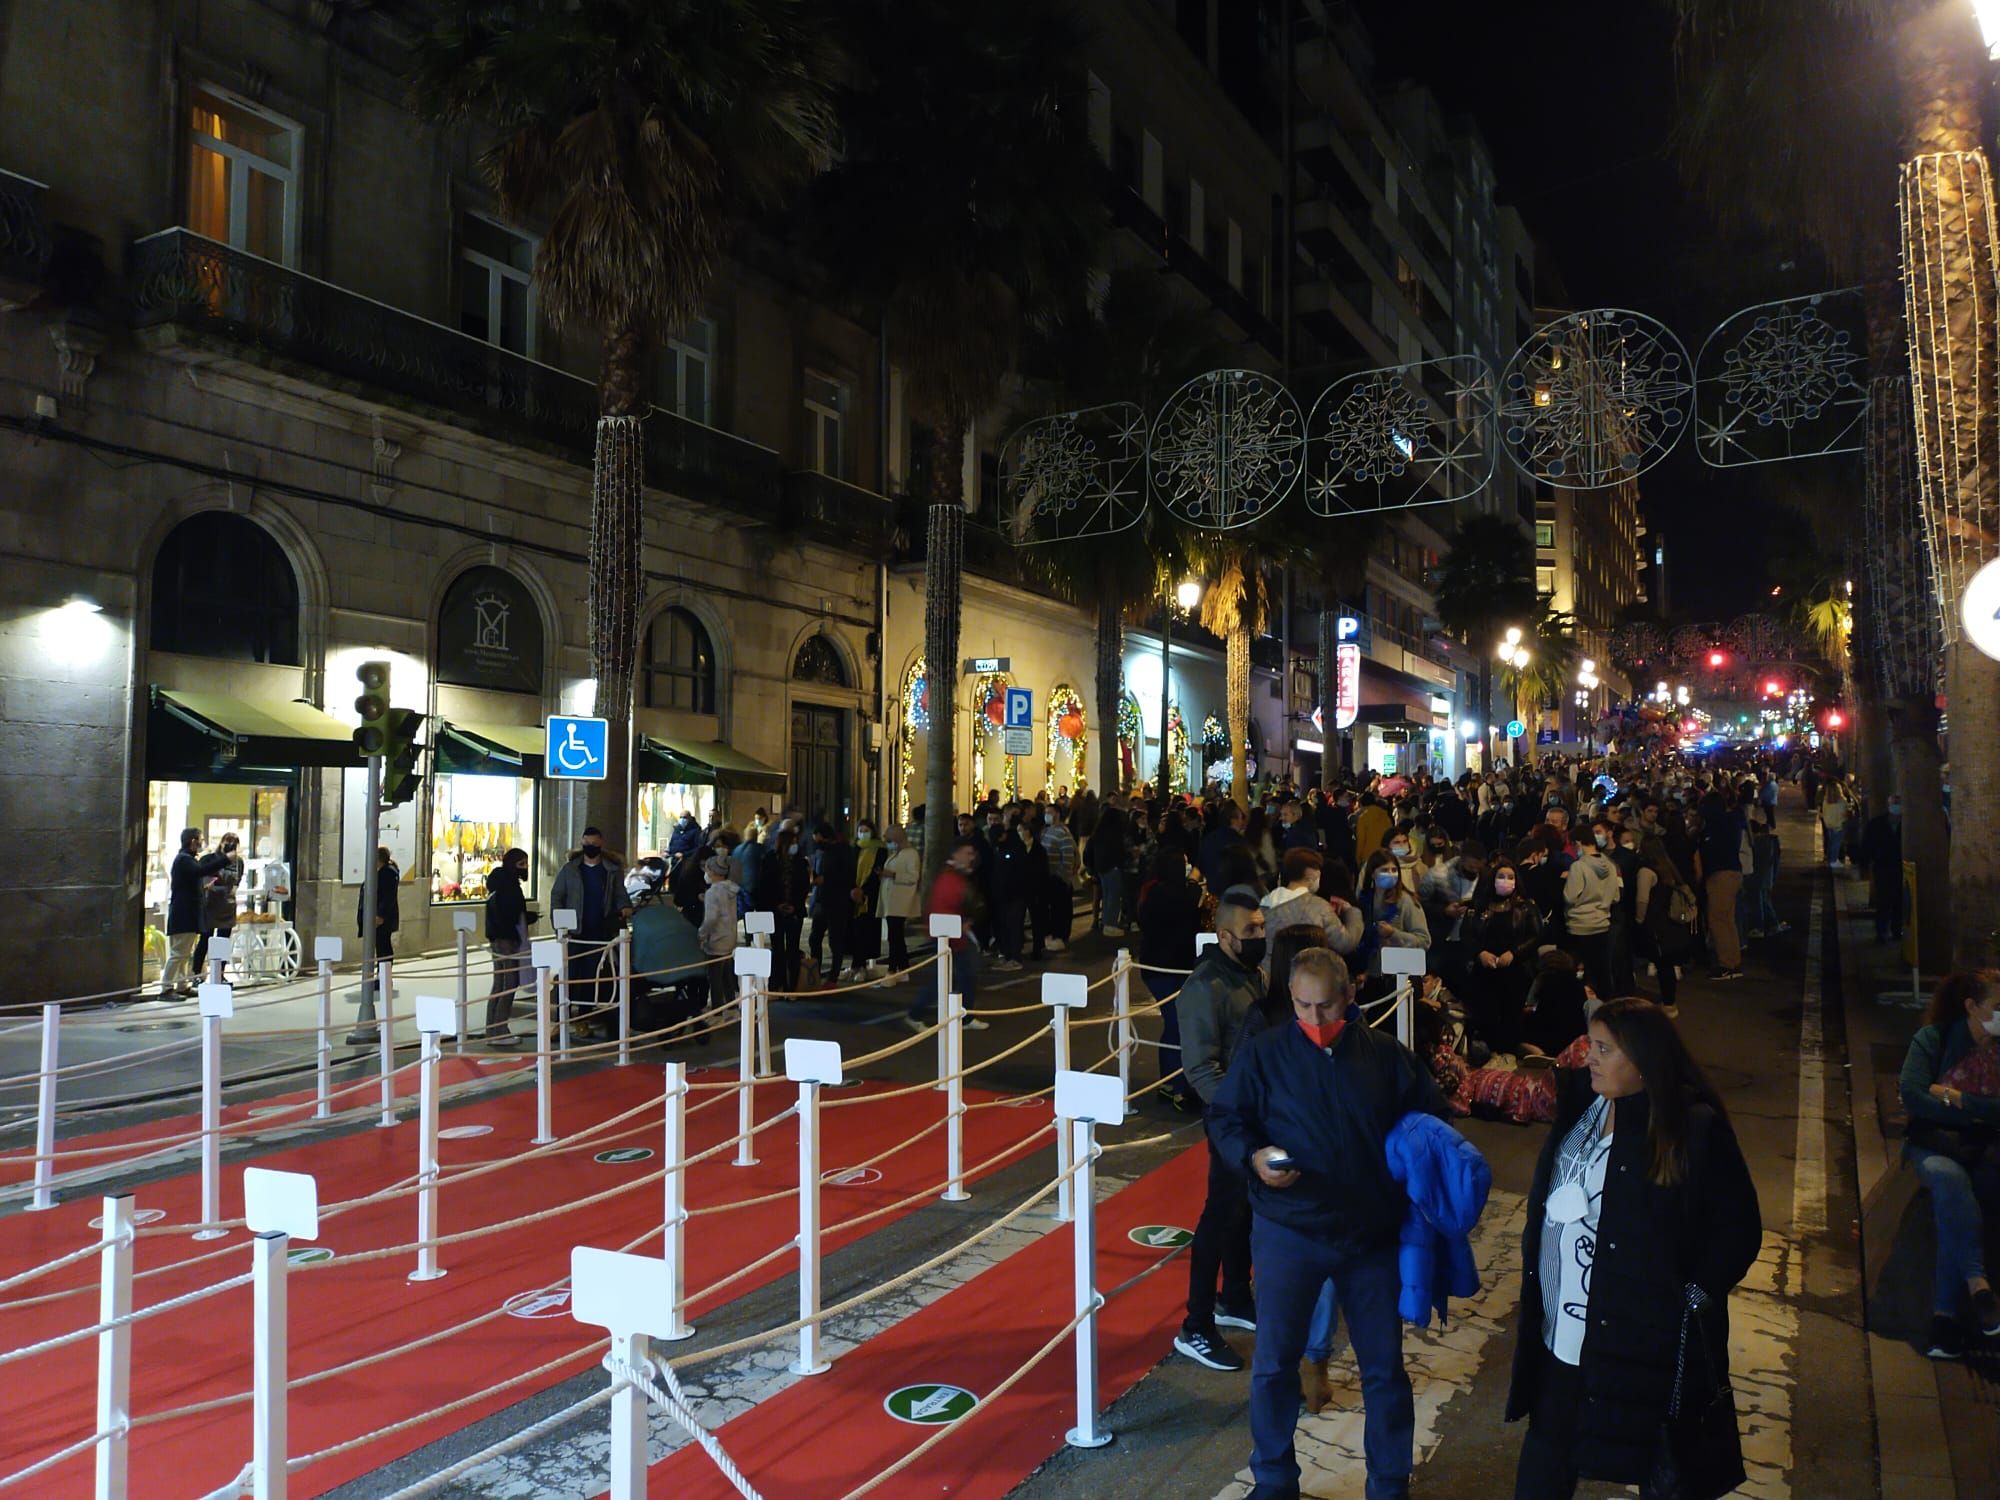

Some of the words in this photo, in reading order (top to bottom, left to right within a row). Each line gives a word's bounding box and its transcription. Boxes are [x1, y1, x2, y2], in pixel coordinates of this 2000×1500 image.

[1338, 617, 1358, 640] P
[1340, 647, 1354, 707] GARAJE
[1012, 694, 1029, 724] P
[913, 1390, 953, 1416] ENTRADA
